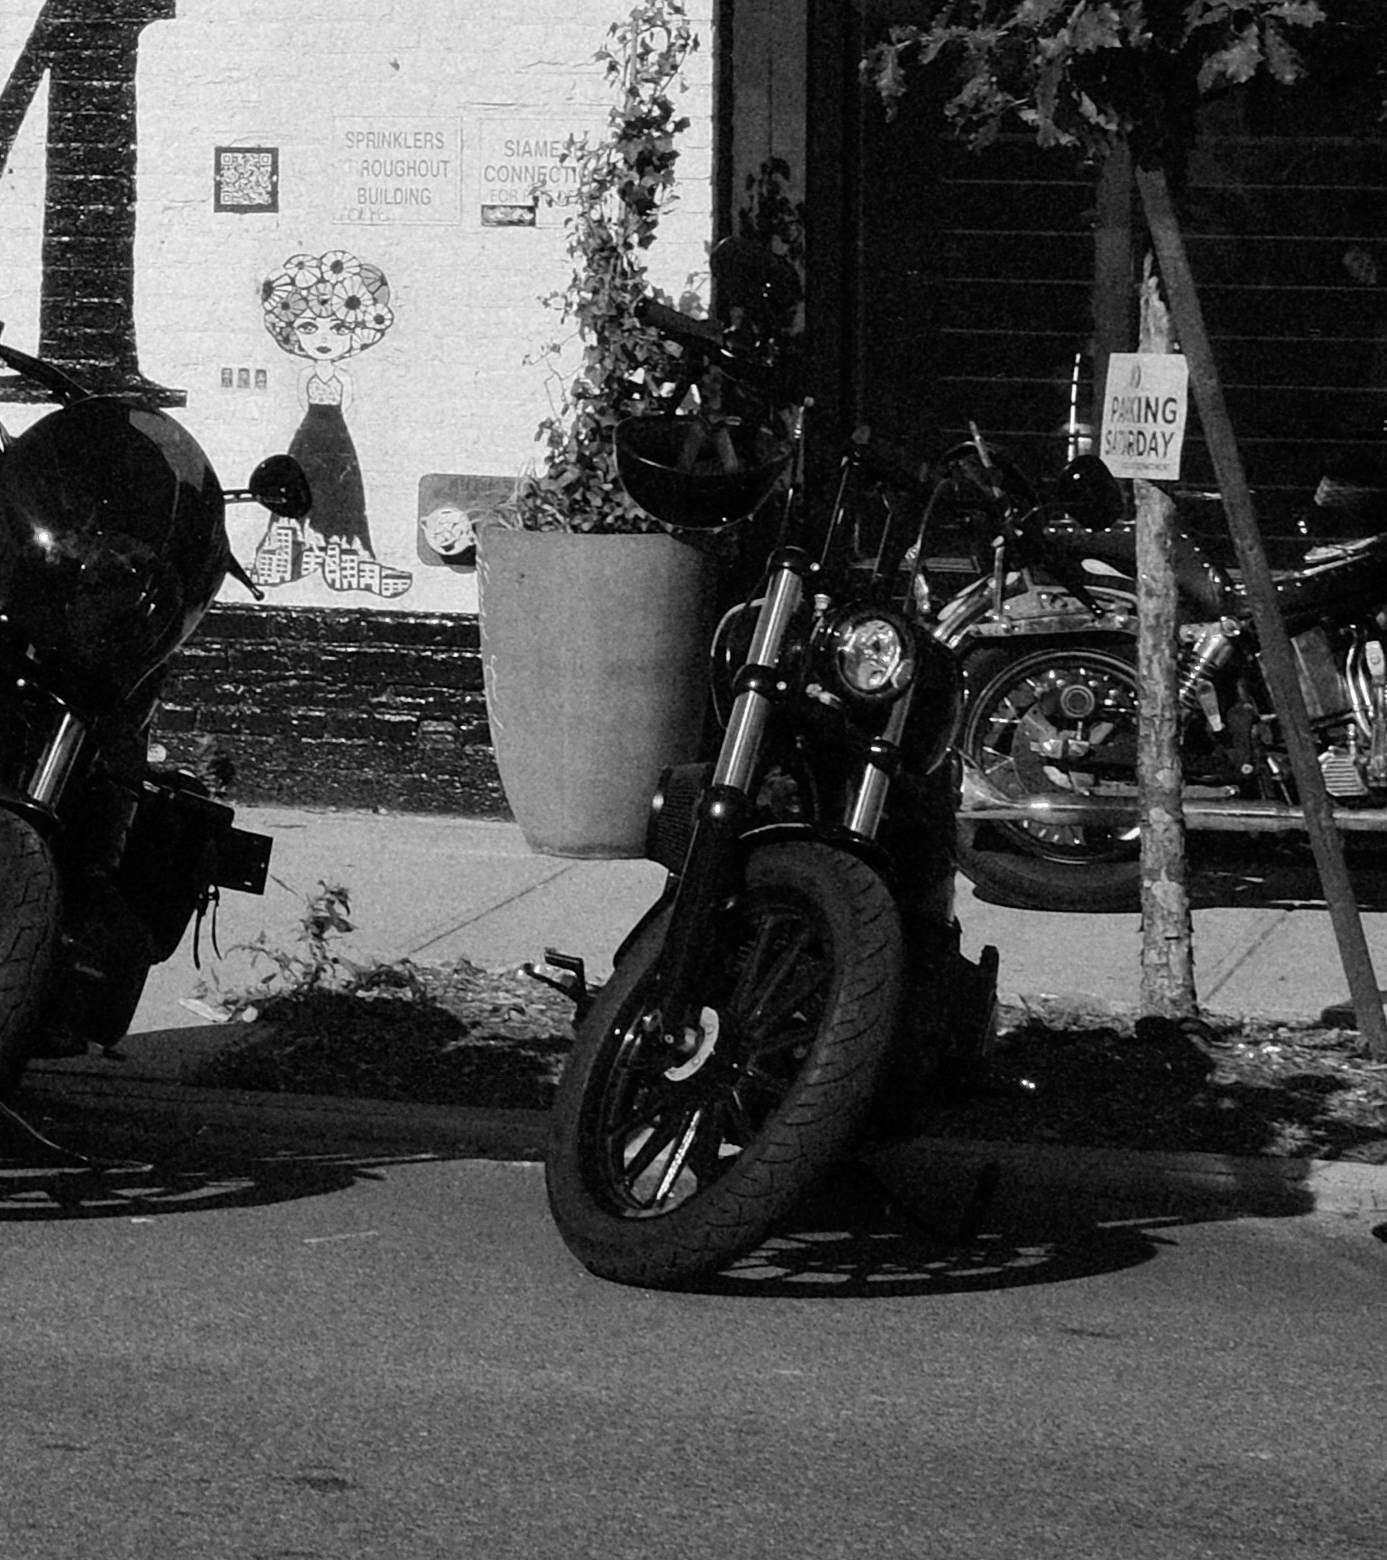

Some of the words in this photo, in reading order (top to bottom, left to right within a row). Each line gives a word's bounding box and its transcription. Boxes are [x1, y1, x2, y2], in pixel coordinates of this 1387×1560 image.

[345, 130, 445, 150] SPRINKLERS
[346, 159, 450, 179] ROUGHOUT
[357, 187, 432, 205] BUILDING
